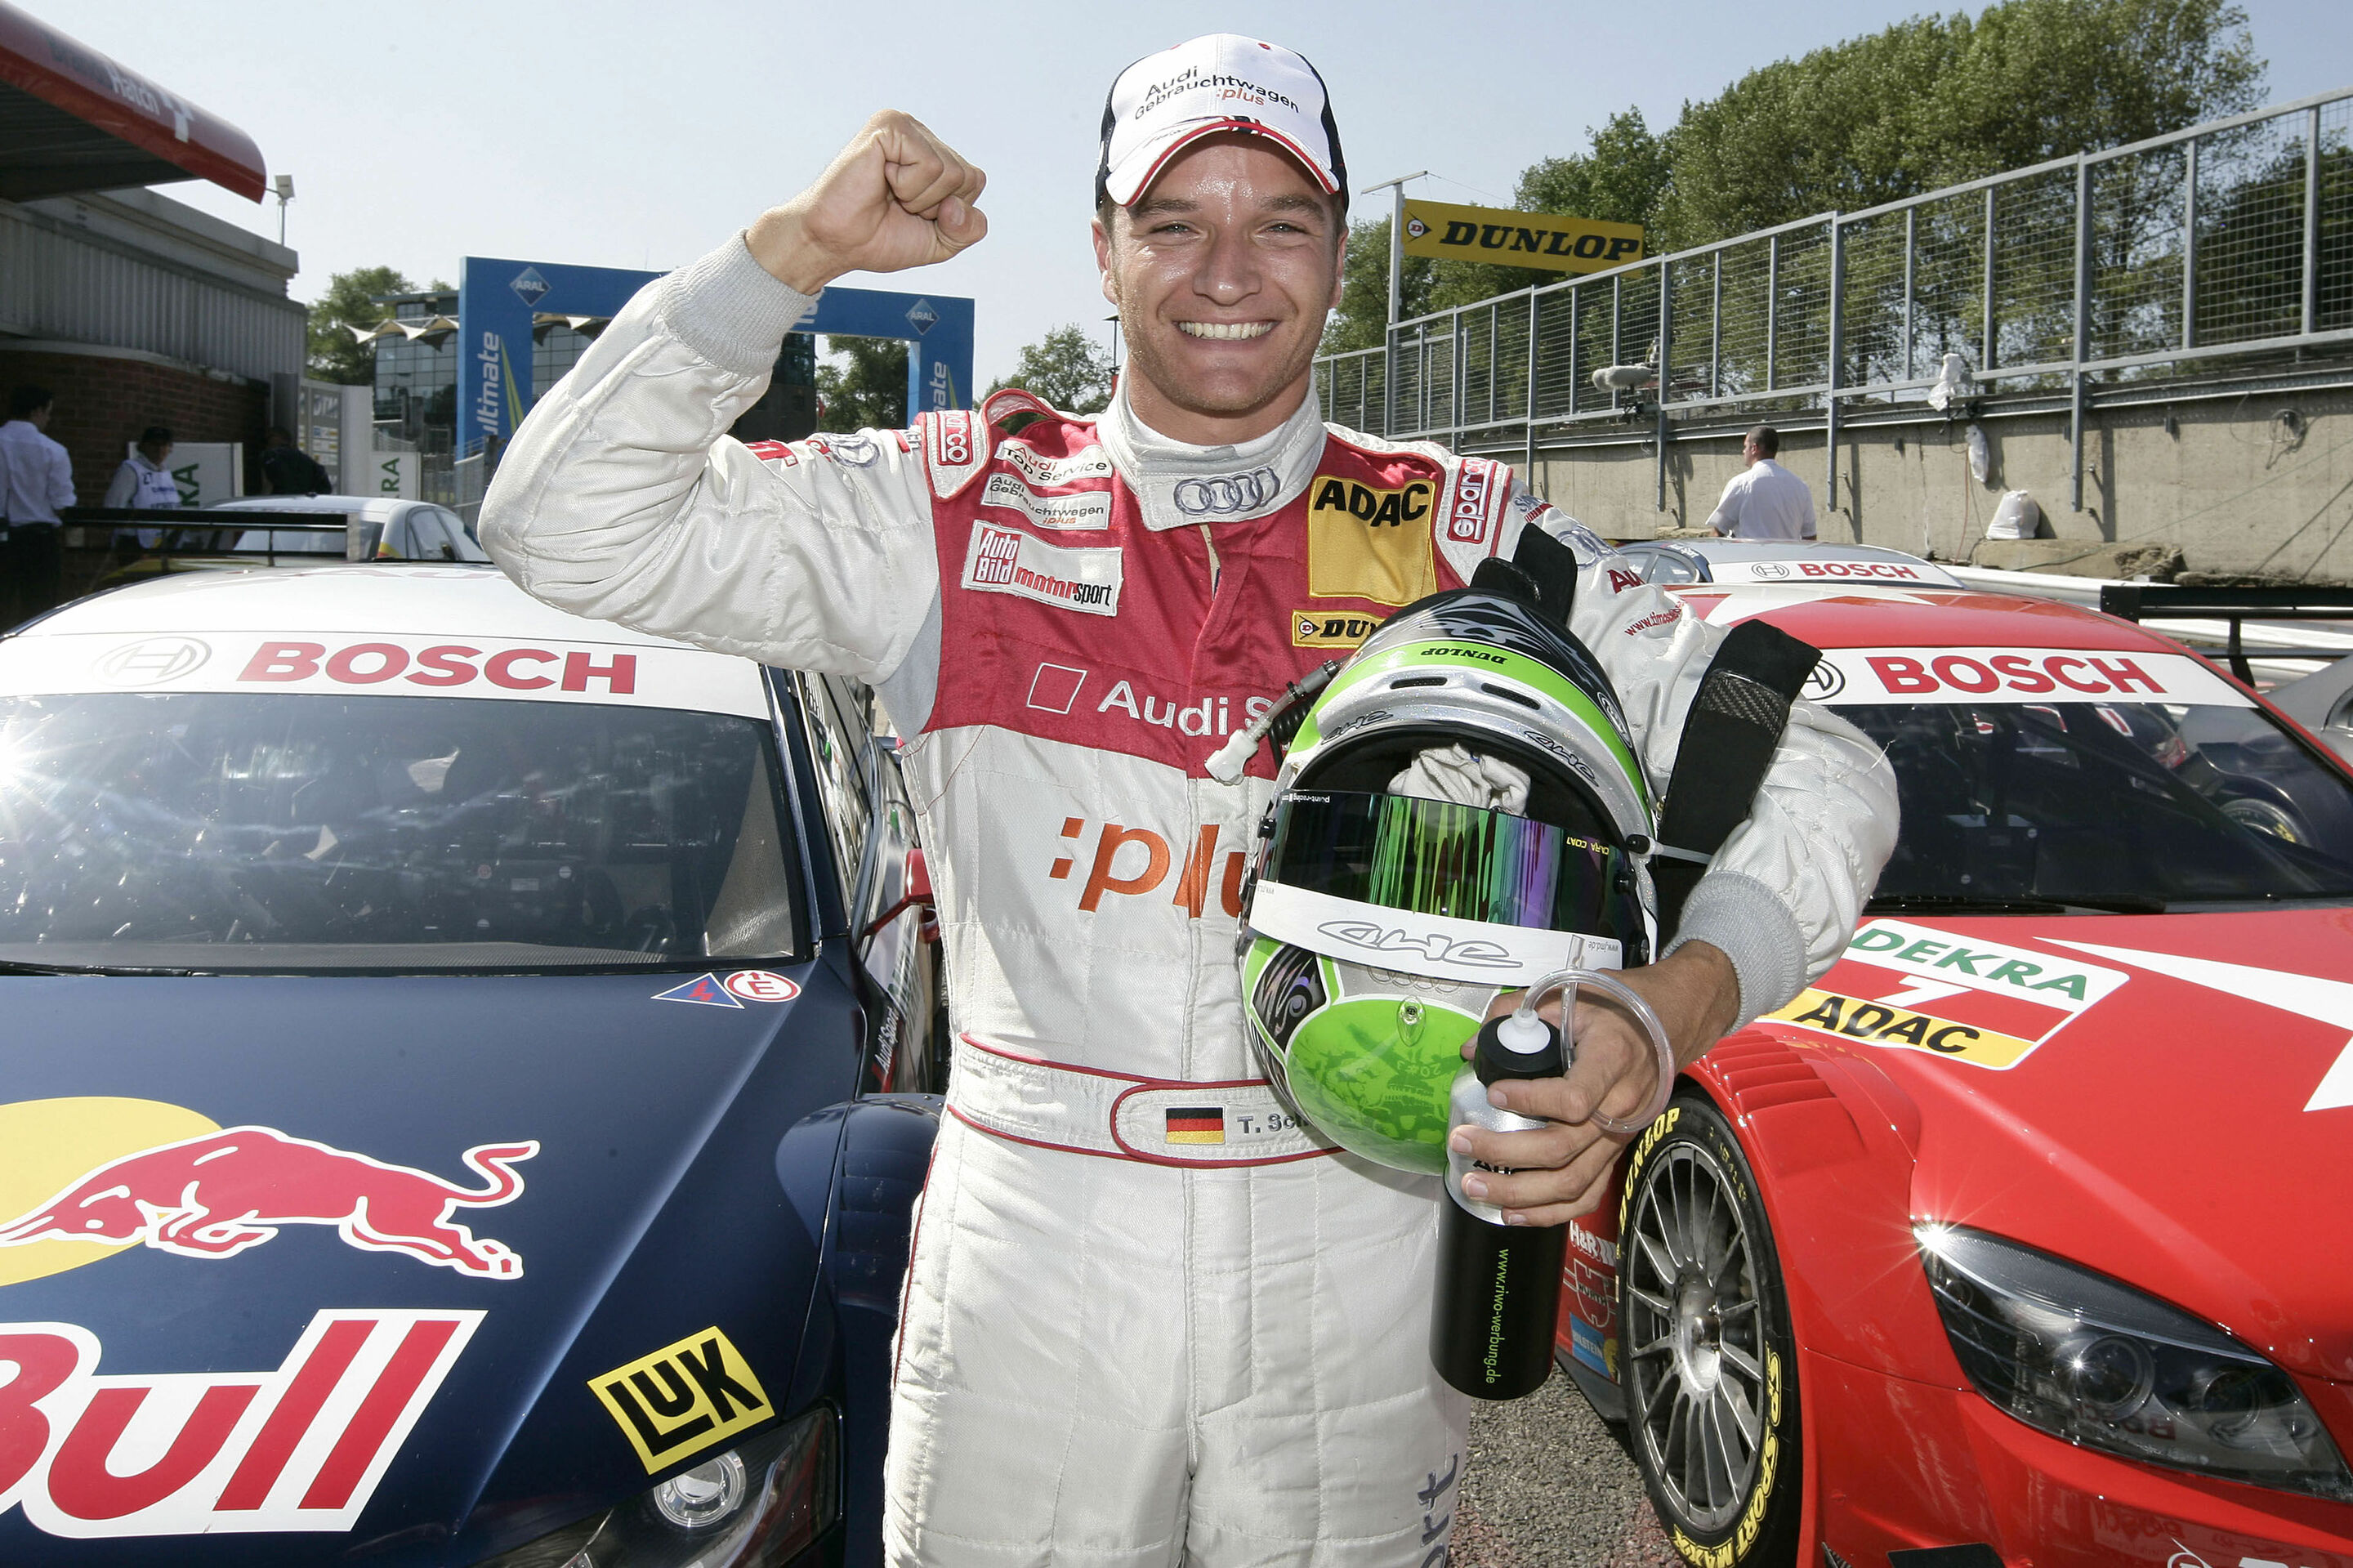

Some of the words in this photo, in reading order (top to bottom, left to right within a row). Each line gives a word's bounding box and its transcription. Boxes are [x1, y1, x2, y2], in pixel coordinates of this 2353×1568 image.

[1135, 74, 1300, 120] Gebrauchtwagen
[1145, 65, 1198, 101] Audi
[1440, 220, 1640, 261] DUNLOP
[516, 280, 546, 292] ARAL
[909, 311, 935, 322] ARAL
[940, 410, 968, 463] parco
[1005, 449, 1034, 475] Top
[1039, 461, 1108, 482] Service
[1015, 446, 1058, 471] Audi
[989, 482, 1105, 517] Gebrauchtwagen
[992, 476, 1025, 493] Audi
[1314, 480, 1430, 528] ADAC
[980, 529, 1020, 560] Auto
[977, 557, 1014, 584] Bild
[1797, 561, 1919, 580] BOSCH
[237, 641, 636, 694] BOSCH
[1421, 647, 1507, 665] DUNLOP
[1865, 656, 2168, 695] BOSCH
[1096, 680, 1229, 735] Audi
[1851, 927, 2087, 1001] DEKRA
[1792, 995, 1981, 1055] ADAC
[1237, 1115, 1261, 1134] T.
[1619, 1107, 1681, 1235] DUNLOP
[1569, 1219, 1599, 1259] H&R
[1483, 1249, 1510, 1383] www.riwo-werbung.de
